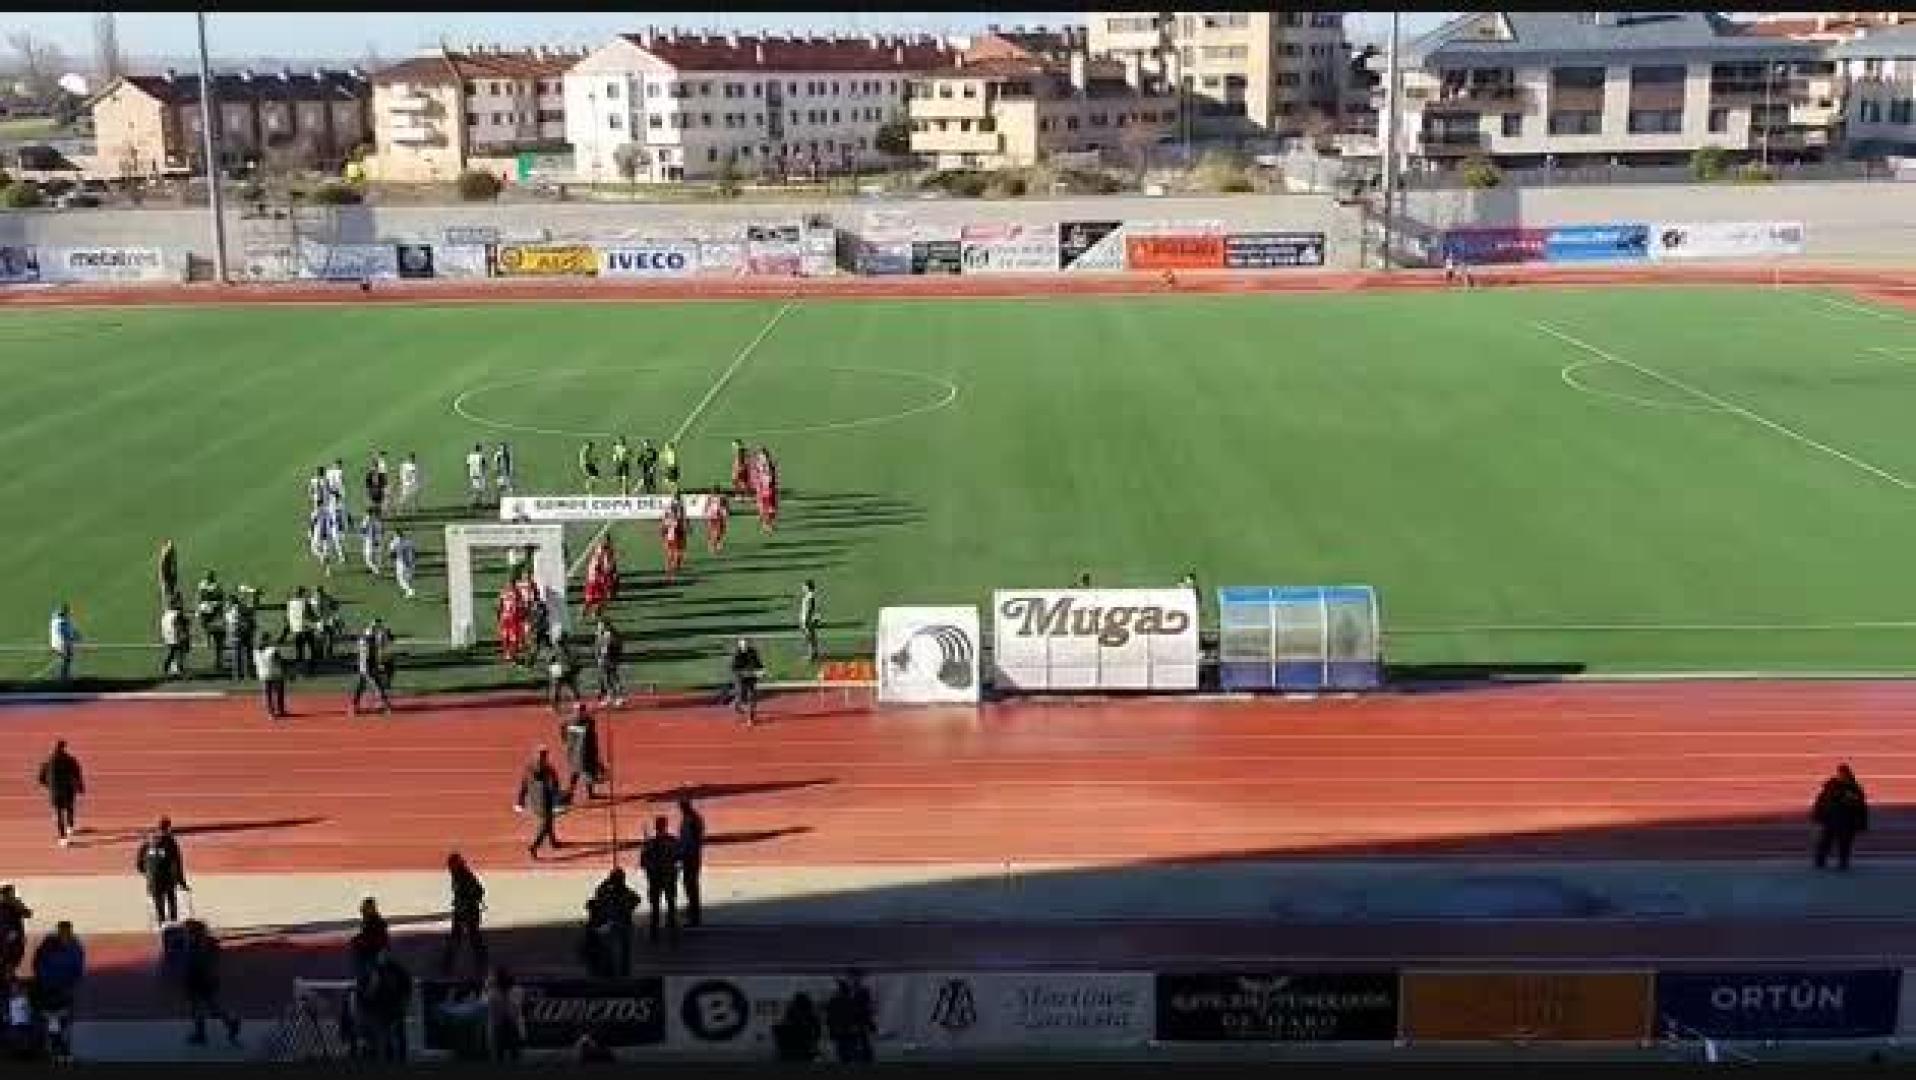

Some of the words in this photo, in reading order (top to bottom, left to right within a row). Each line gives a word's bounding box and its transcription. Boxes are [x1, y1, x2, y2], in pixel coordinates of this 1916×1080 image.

[609, 252, 685, 270] IVECO
[1001, 596, 1190, 647] Muga
[1710, 979, 1844, 1010] ORTÚN
